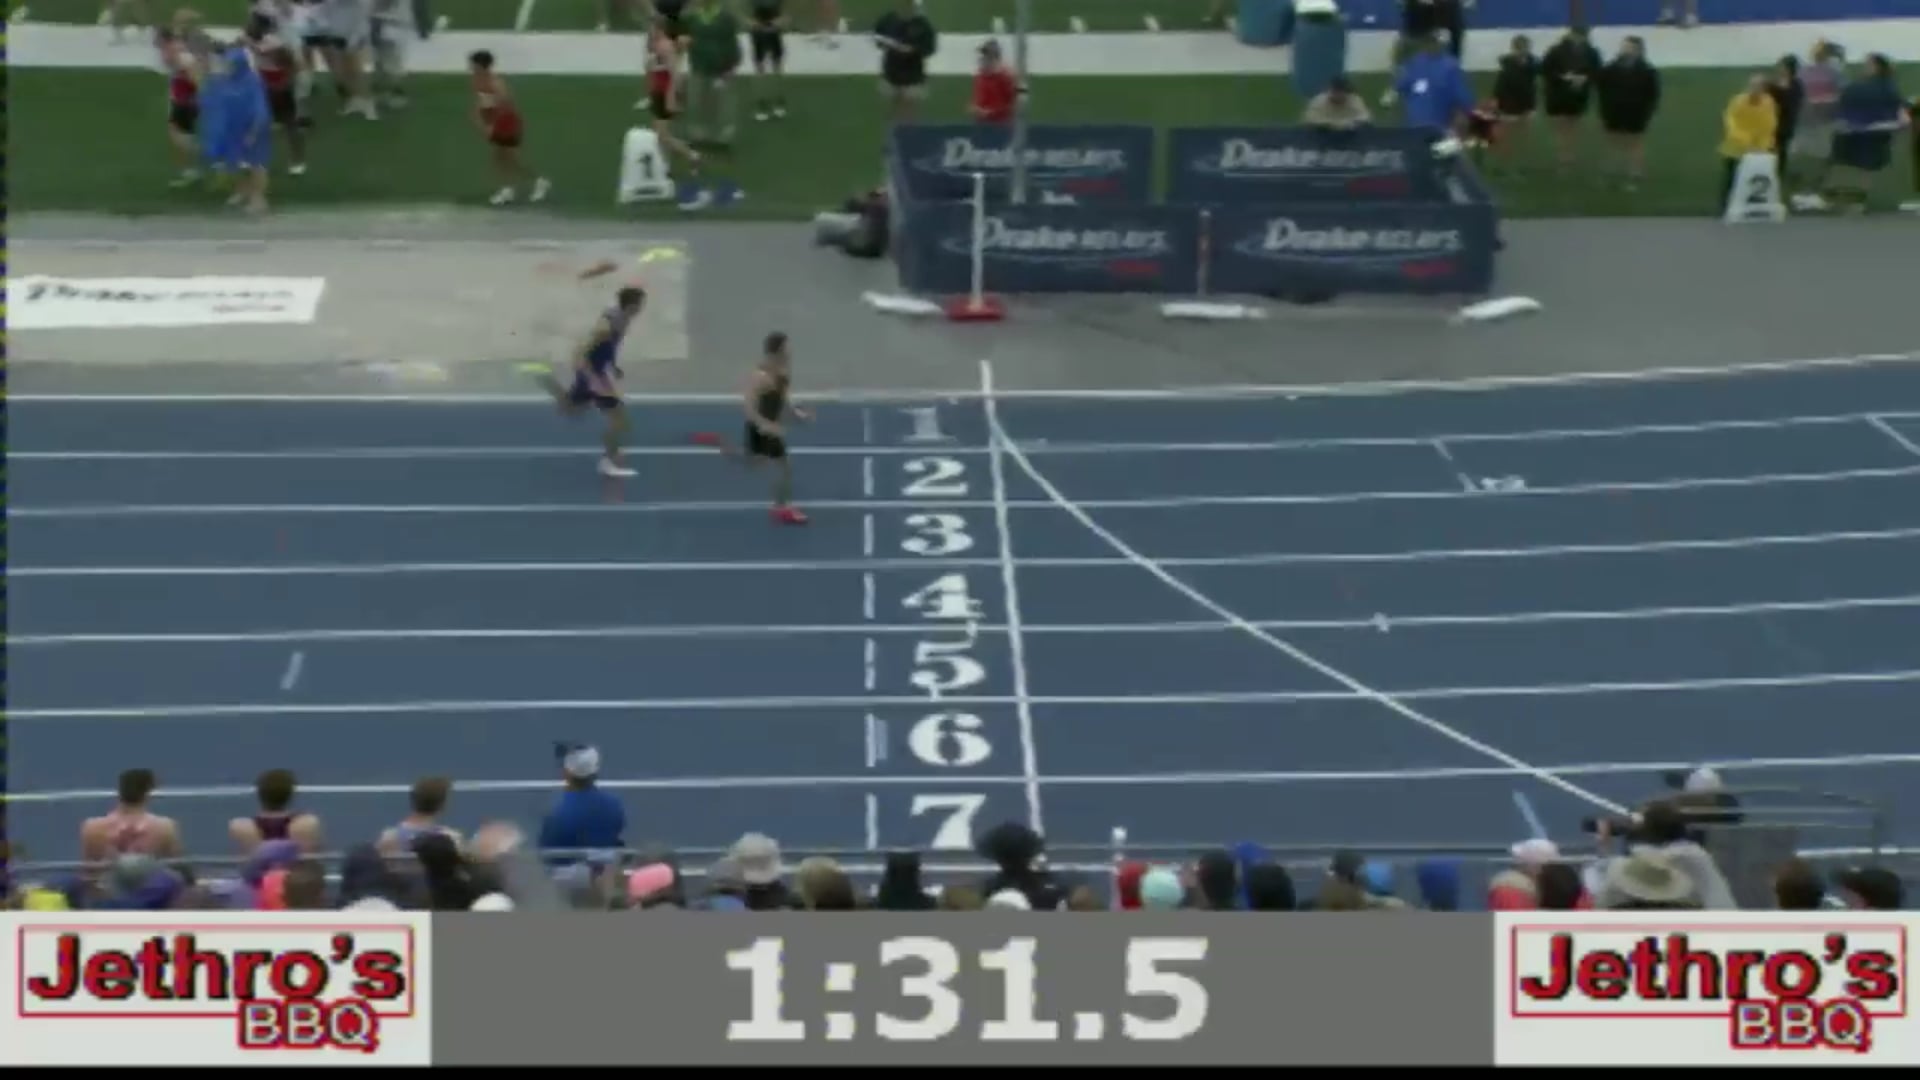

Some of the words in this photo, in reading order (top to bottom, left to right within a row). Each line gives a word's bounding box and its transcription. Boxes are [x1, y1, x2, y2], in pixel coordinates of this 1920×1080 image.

[638, 153, 653, 179] 1
[1220, 138, 1318, 168] Drake
[1747, 174, 1771, 204] 2
[1264, 217, 1369, 249] Drake
[899, 407, 957, 441] 1
[902, 456, 968, 496] 2
[901, 514, 974, 555] 3
[901, 574, 986, 618] 4
[910, 621, 985, 701] 5
[907, 712, 993, 766] 6
[909, 793, 986, 850] 7
